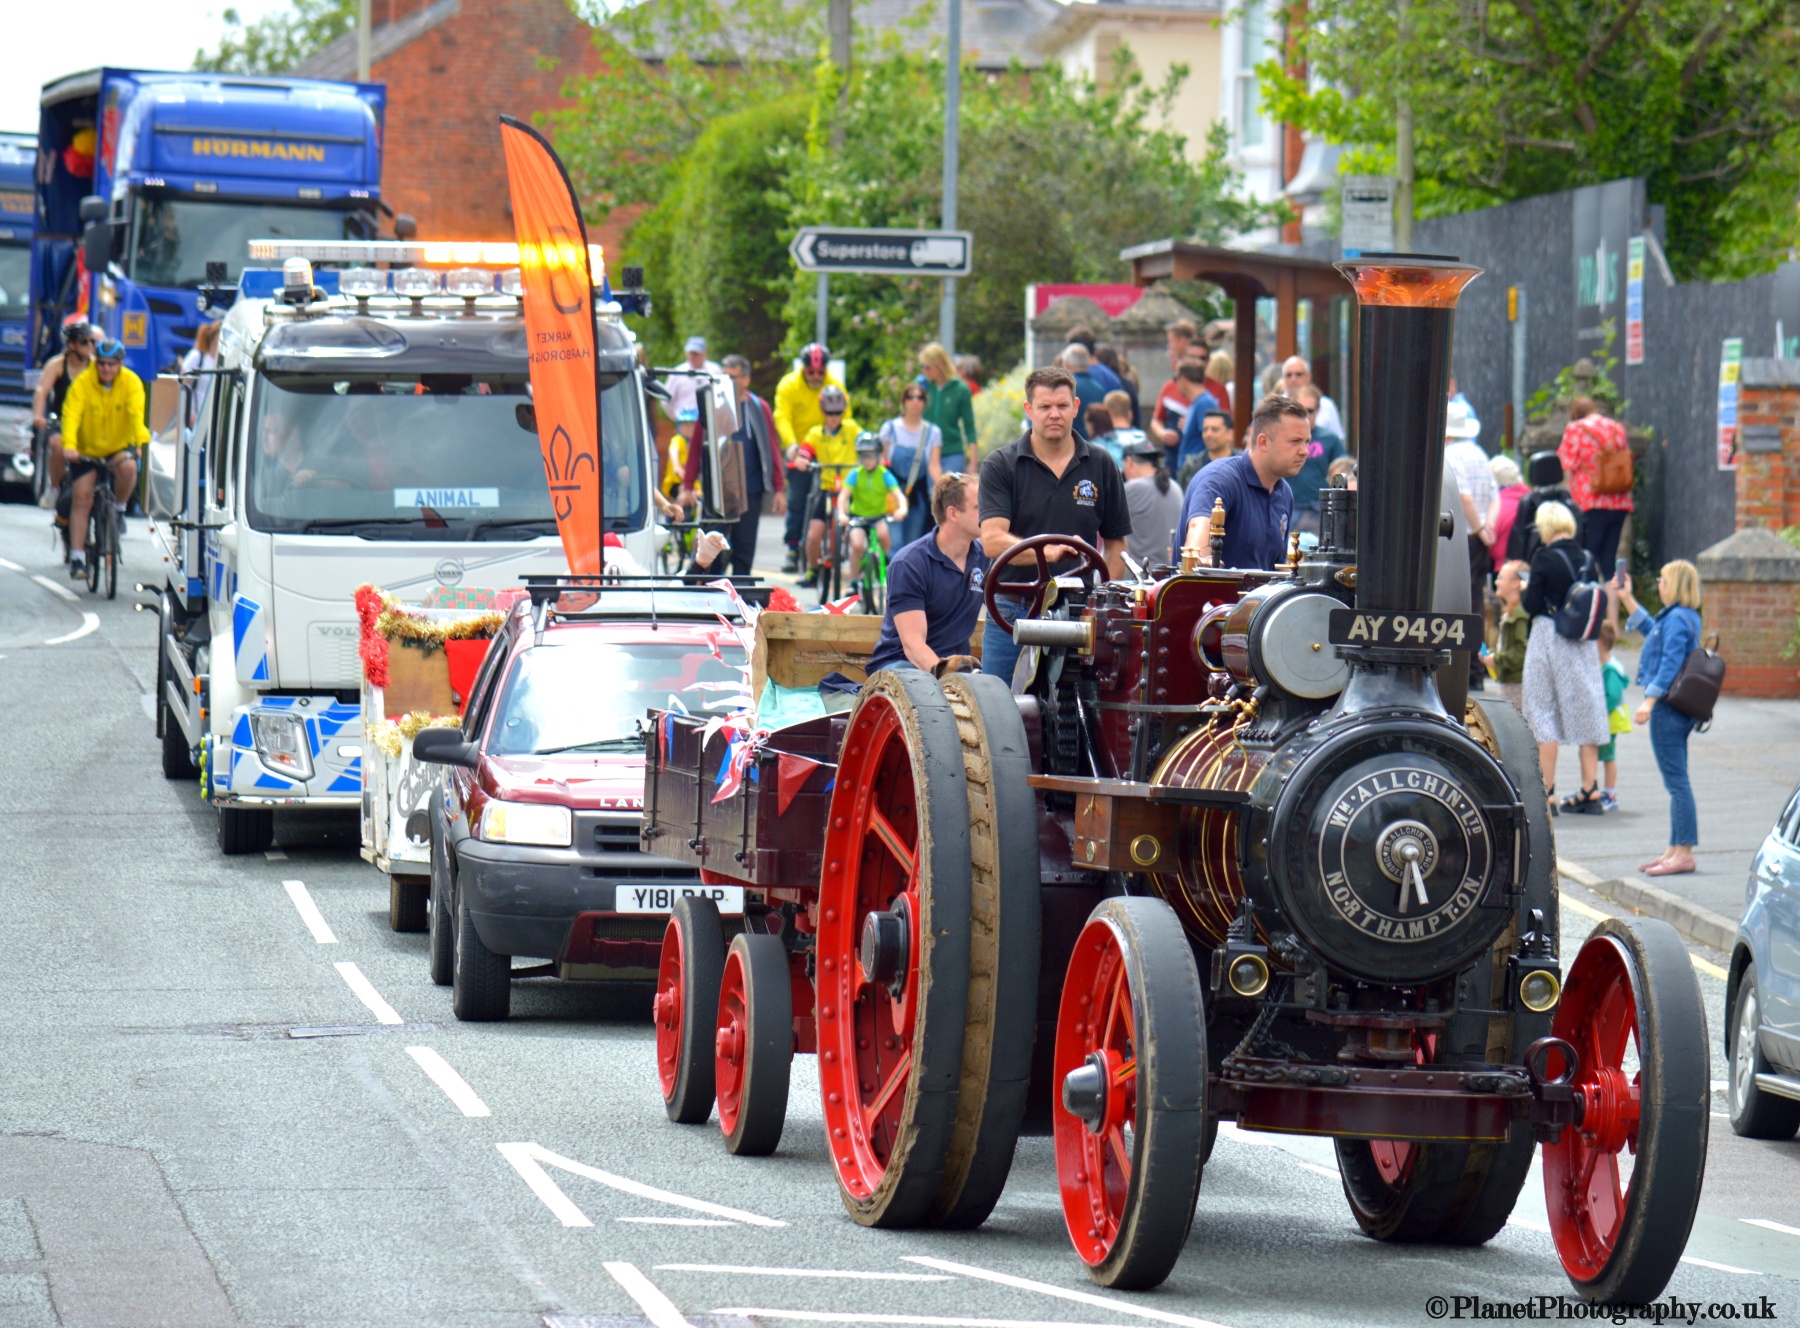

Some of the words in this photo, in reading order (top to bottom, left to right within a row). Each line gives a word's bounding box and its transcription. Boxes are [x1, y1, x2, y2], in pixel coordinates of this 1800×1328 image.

[817, 240, 907, 261] Superstore
[415, 490, 480, 507] ANIMAL
[1347, 614, 1387, 641] AY
[1392, 615, 1465, 646] 9494
[1357, 771, 1462, 808] ALLCHIN
[600, 798, 644, 807] LAN
[1390, 827, 1425, 842] ALLCHIN
